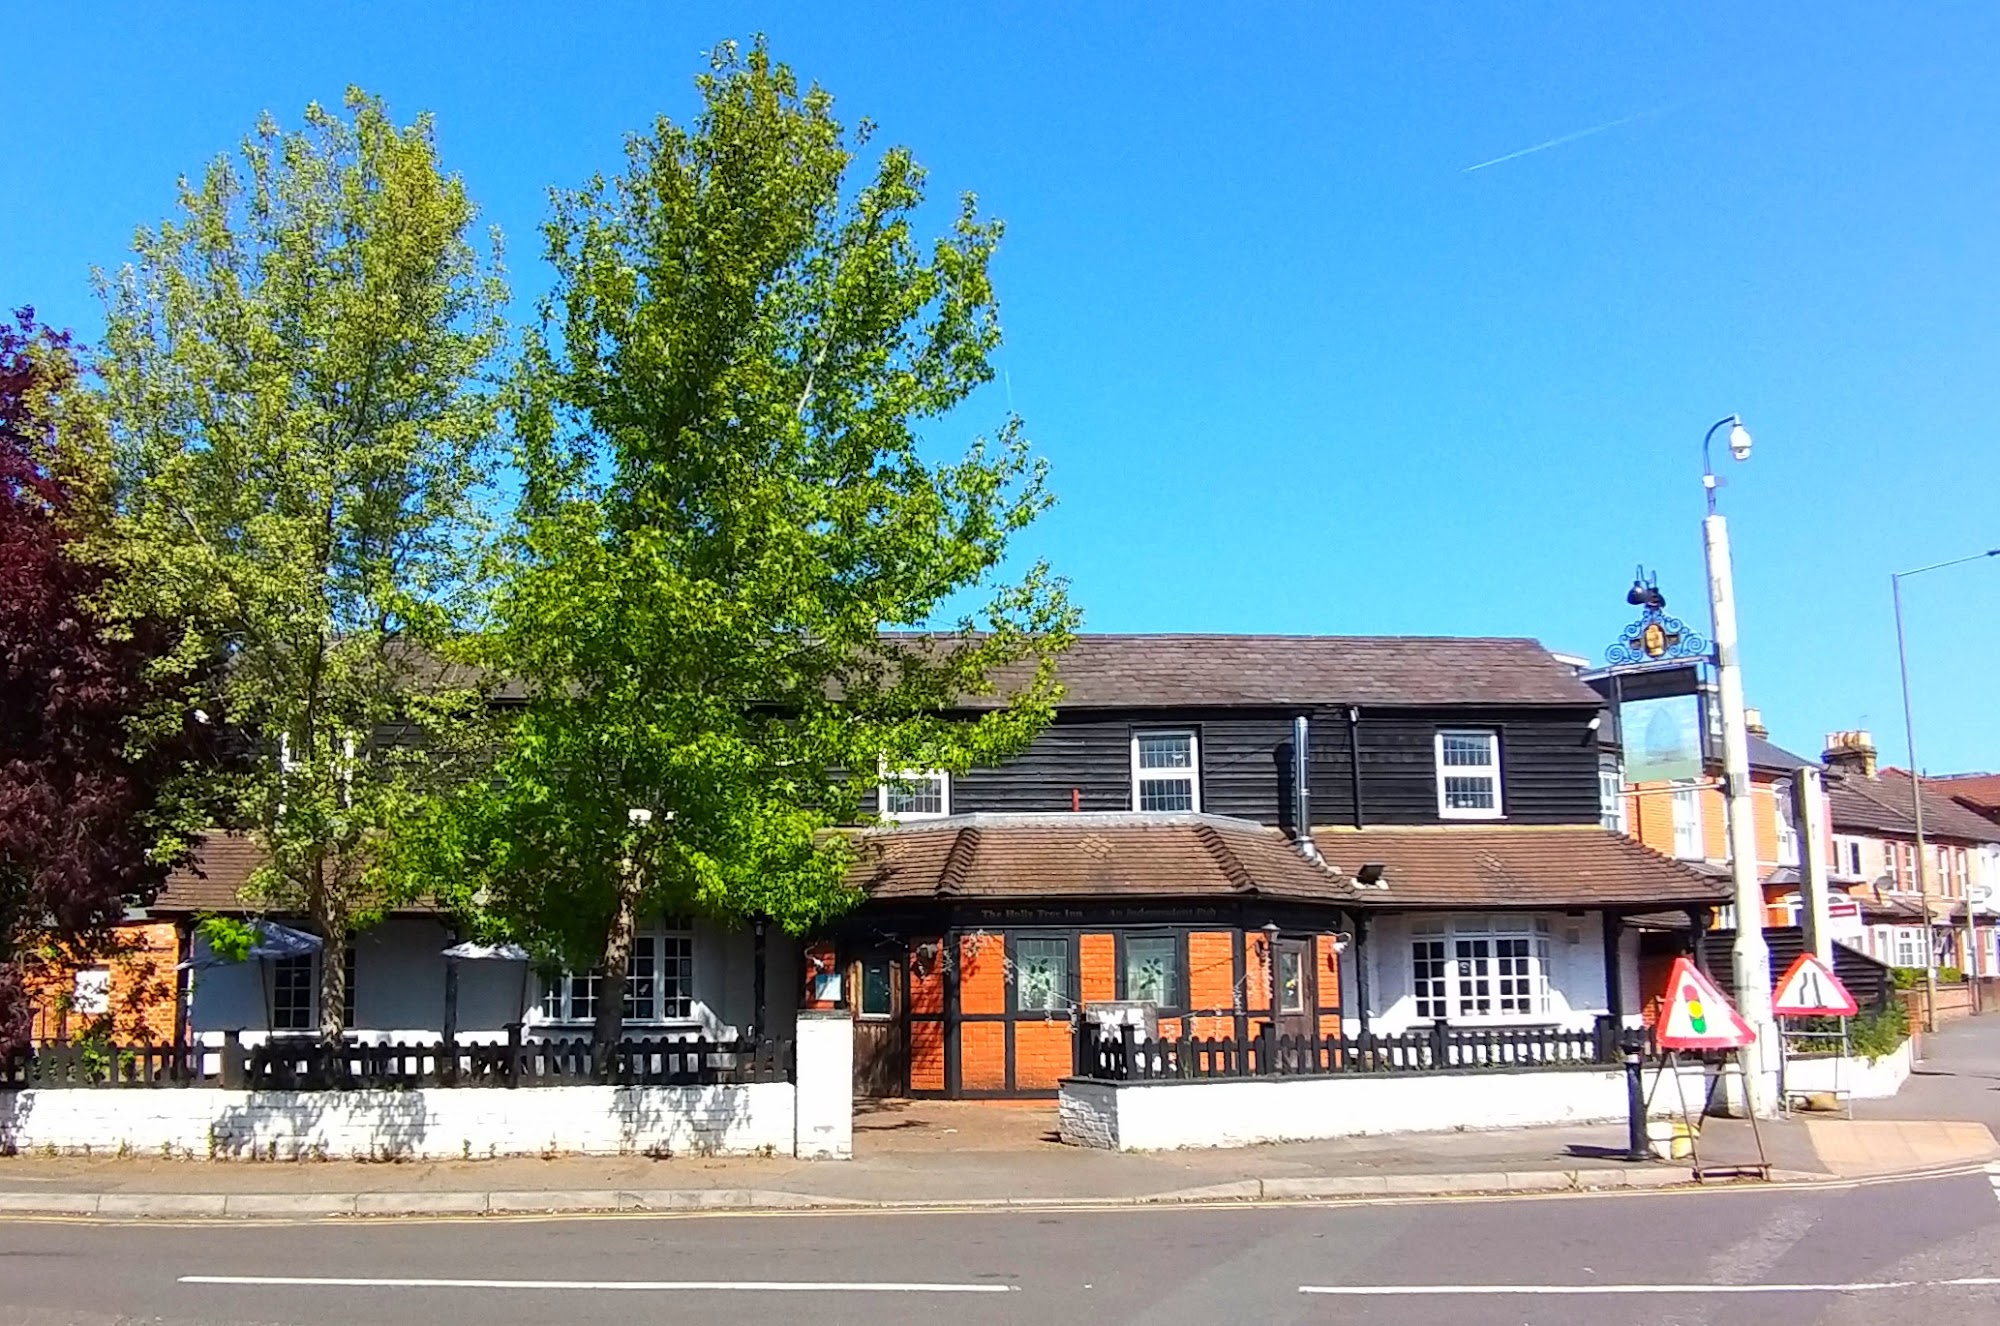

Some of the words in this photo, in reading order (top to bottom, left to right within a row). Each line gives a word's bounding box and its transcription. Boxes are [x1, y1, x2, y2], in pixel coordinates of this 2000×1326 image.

[980, 909, 1002, 918] The
[1005, 909, 1034, 919] Holly
[1036, 909, 1061, 918] Tree
[1064, 909, 1083, 918] Inn
